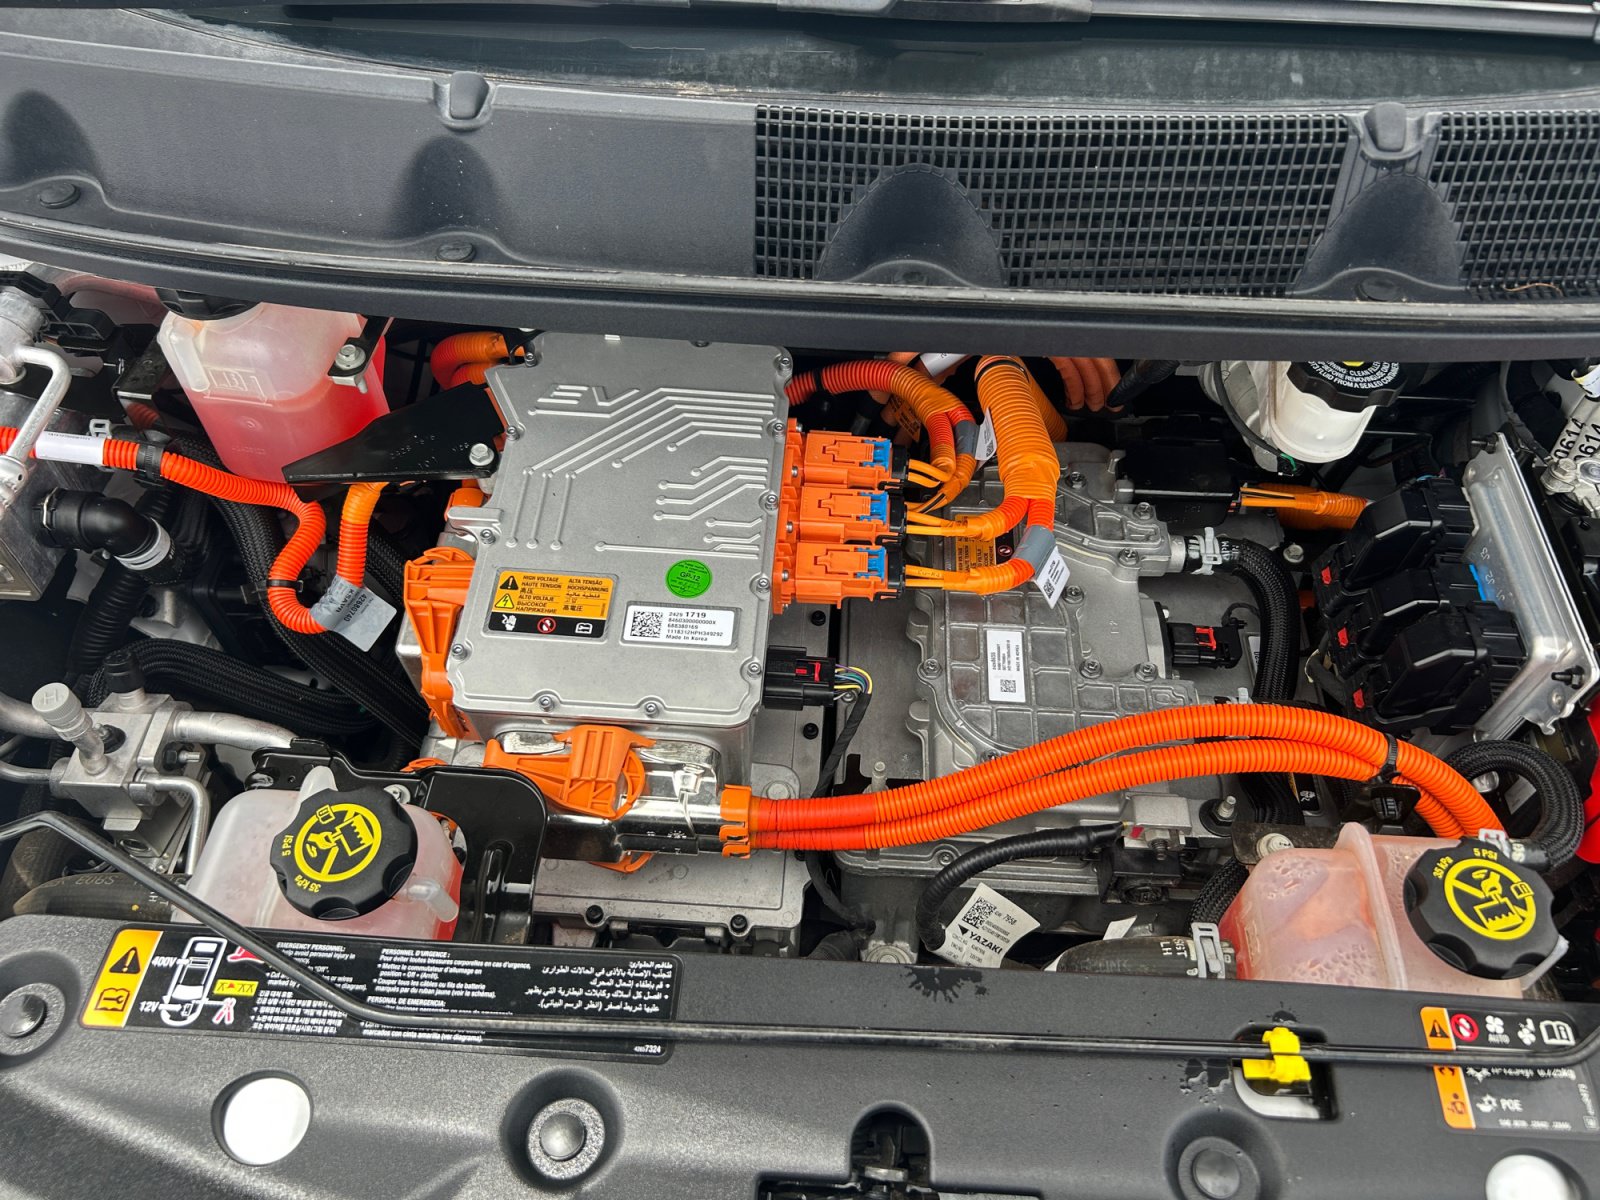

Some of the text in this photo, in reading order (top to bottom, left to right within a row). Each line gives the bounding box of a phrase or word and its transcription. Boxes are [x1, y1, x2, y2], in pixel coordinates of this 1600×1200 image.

[1316, 367, 1334, 380] FLUID
[1333, 377, 1354, 388] FROM
[1360, 380, 1384, 389] SEALED
[1553, 417, 1586, 460] 0614
[680, 572, 701, 581] GP-12
[567, 585, 609, 593] HOCHSPANNUNG
[343, 593, 368, 622] 42680740
[685, 611, 707, 619] 1719
[281, 834, 295, 857] 5 PSI
[1473, 848, 1498, 861] 5 PSI
[1432, 856, 1454, 880] 35 kPa
[294, 874, 322, 893] 35 kPa
[276, 942, 346, 953] EMERGENCY PERSONNEL:
[968, 931, 1003, 955] YAZAKI
[1159, 941, 1173, 956] LH
[309, 951, 334, 959] personal
[334, 953, 349, 961] injury
[381, 948, 414, 956] PERSONNEL
[415, 950, 448, 958] D'URGENCE
[152, 956, 177, 968] 400V
[379, 970, 402, 978] position
[408, 965, 443, 973] commutateur
[377, 978, 397, 986] Couper
[434, 988, 451, 996] jaune
[139, 1001, 160, 1012] 12V
[367, 995, 397, 1004] PERSONAL
[407, 998, 446, 1007] EMERGENCIA:
[362, 1028, 391, 1037] marcados
[1500, 1098, 1523, 1113] POE
